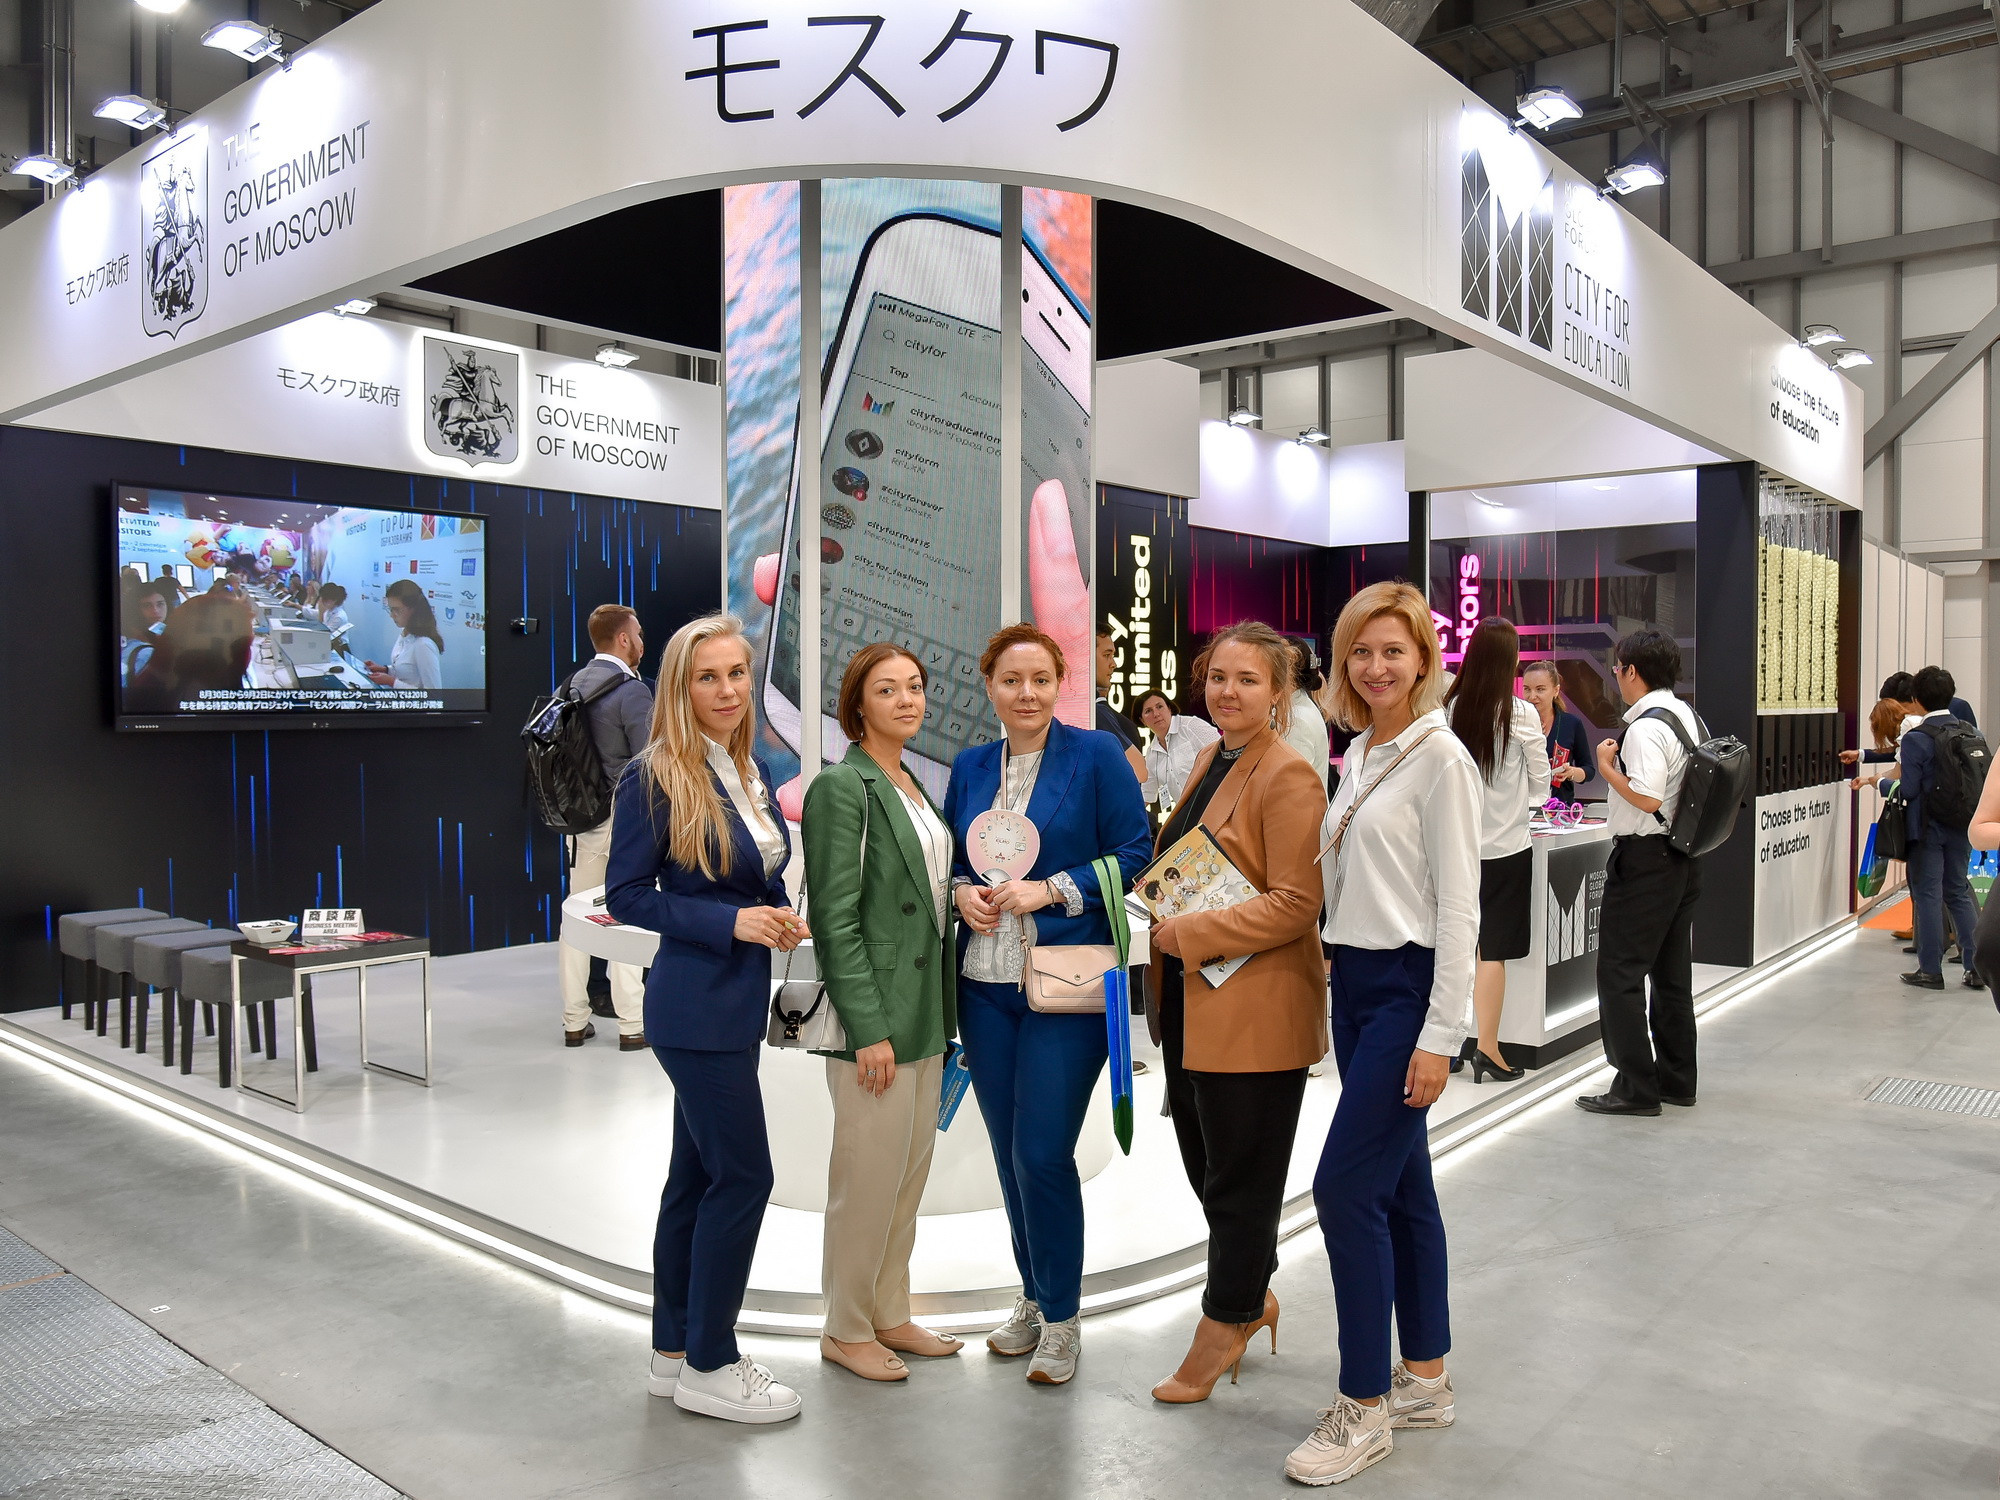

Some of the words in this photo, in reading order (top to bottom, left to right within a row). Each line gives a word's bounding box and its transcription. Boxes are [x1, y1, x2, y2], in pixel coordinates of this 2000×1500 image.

[685, 9, 1120, 133] モスクワ
[222, 122, 260, 171] THE
[224, 119, 370, 224] GOVERNMENT
[224, 236, 249, 277] OF
[255, 187, 356, 265] MOSCOW
[66, 252, 129, 305] モスクワ政府
[1564, 262, 1600, 326] CITY
[1605, 287, 1630, 345] FOR
[905, 340, 946, 358] cityfor
[1564, 321, 1630, 392] EDUCATION
[277, 367, 400, 407] モスクワ政府
[536, 373, 577, 399] THE
[890, 365, 909, 379] Top
[1770, 365, 1801, 401] Choose
[1803, 389, 1816, 411] the
[1817, 397, 1839, 426] future
[537, 405, 680, 445] GOVERNMENT
[1770, 400, 1780, 421] of
[1782, 409, 1820, 444] education
[537, 436, 566, 456] OF
[573, 441, 668, 471] MOSCOW
[1761, 810, 1791, 831] Choose
[1794, 803, 1806, 823] the
[1808, 800, 1830, 818] future
[1761, 841, 1770, 864] of
[1772, 831, 1810, 859] education
[309, 910, 357, 921] 商談席
